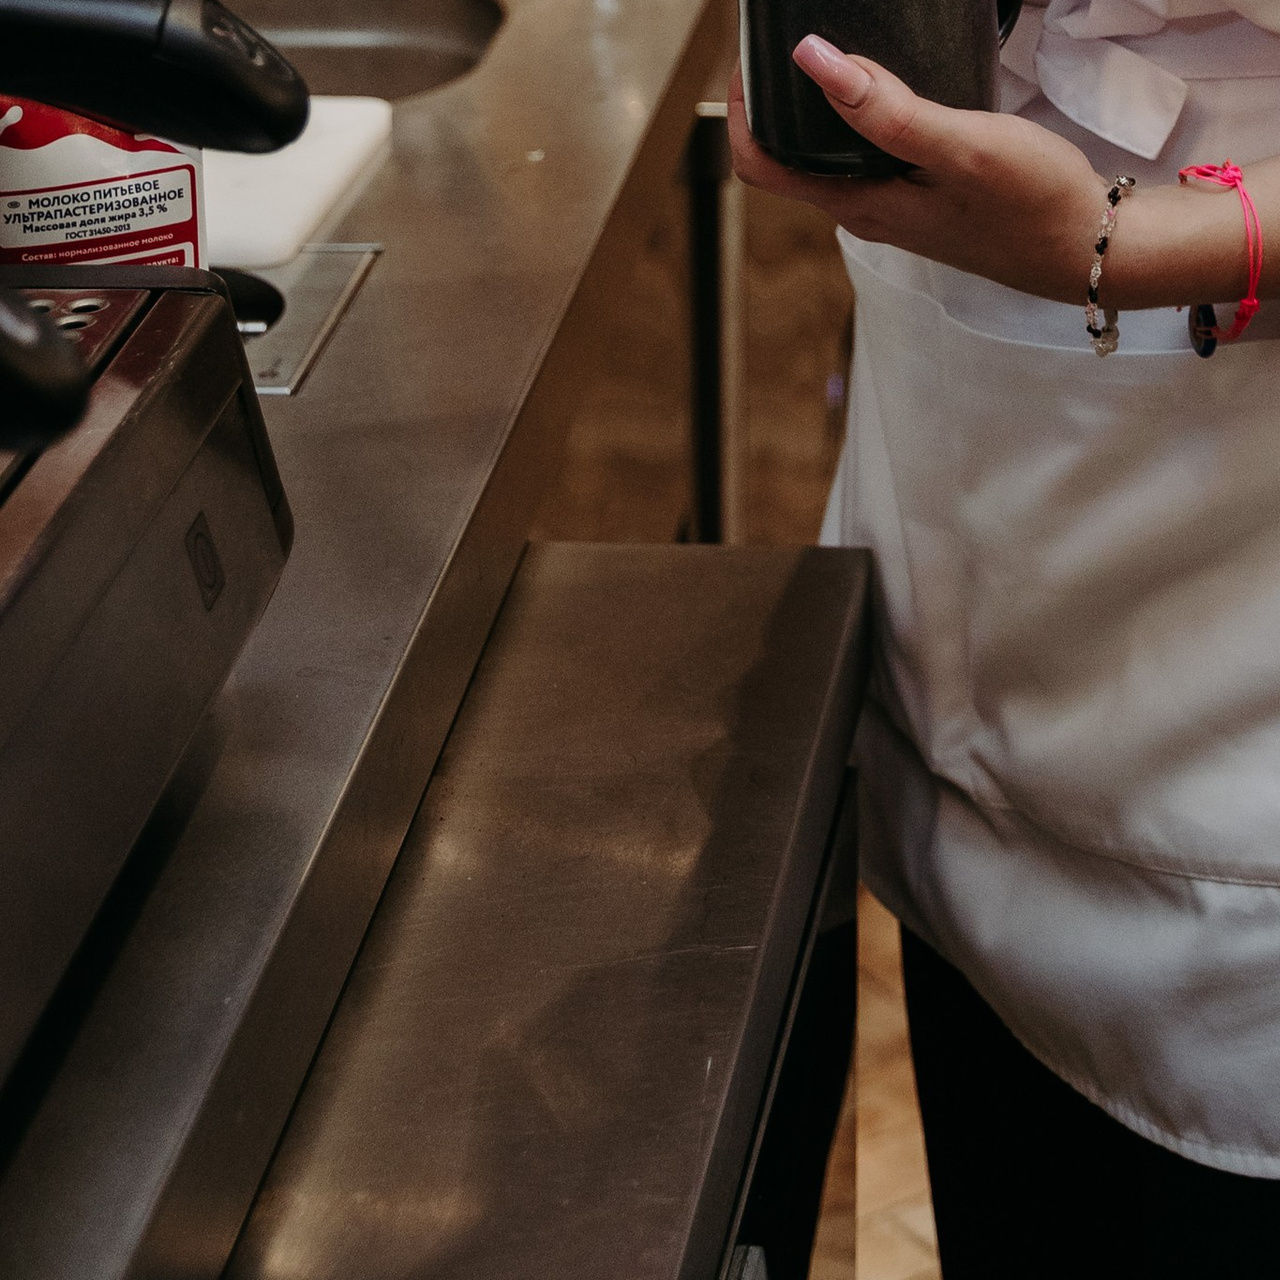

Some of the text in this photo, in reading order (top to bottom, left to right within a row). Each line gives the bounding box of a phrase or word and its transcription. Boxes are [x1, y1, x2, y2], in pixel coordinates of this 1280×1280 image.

[3, 188, 184, 225] УЛЬТРАПАСТЕРИЗОВАННОЕ
[28, 191, 91, 210] МОЛОКО
[93, 180, 160, 201] ПИТЬЕВОЕ
[22, 202, 168, 234] Массовая доля жира 3,5 %
[65, 223, 131, 240] ГОСТ 31450-2013
[21, 233, 174, 261] Состав: нормализованное молоко
